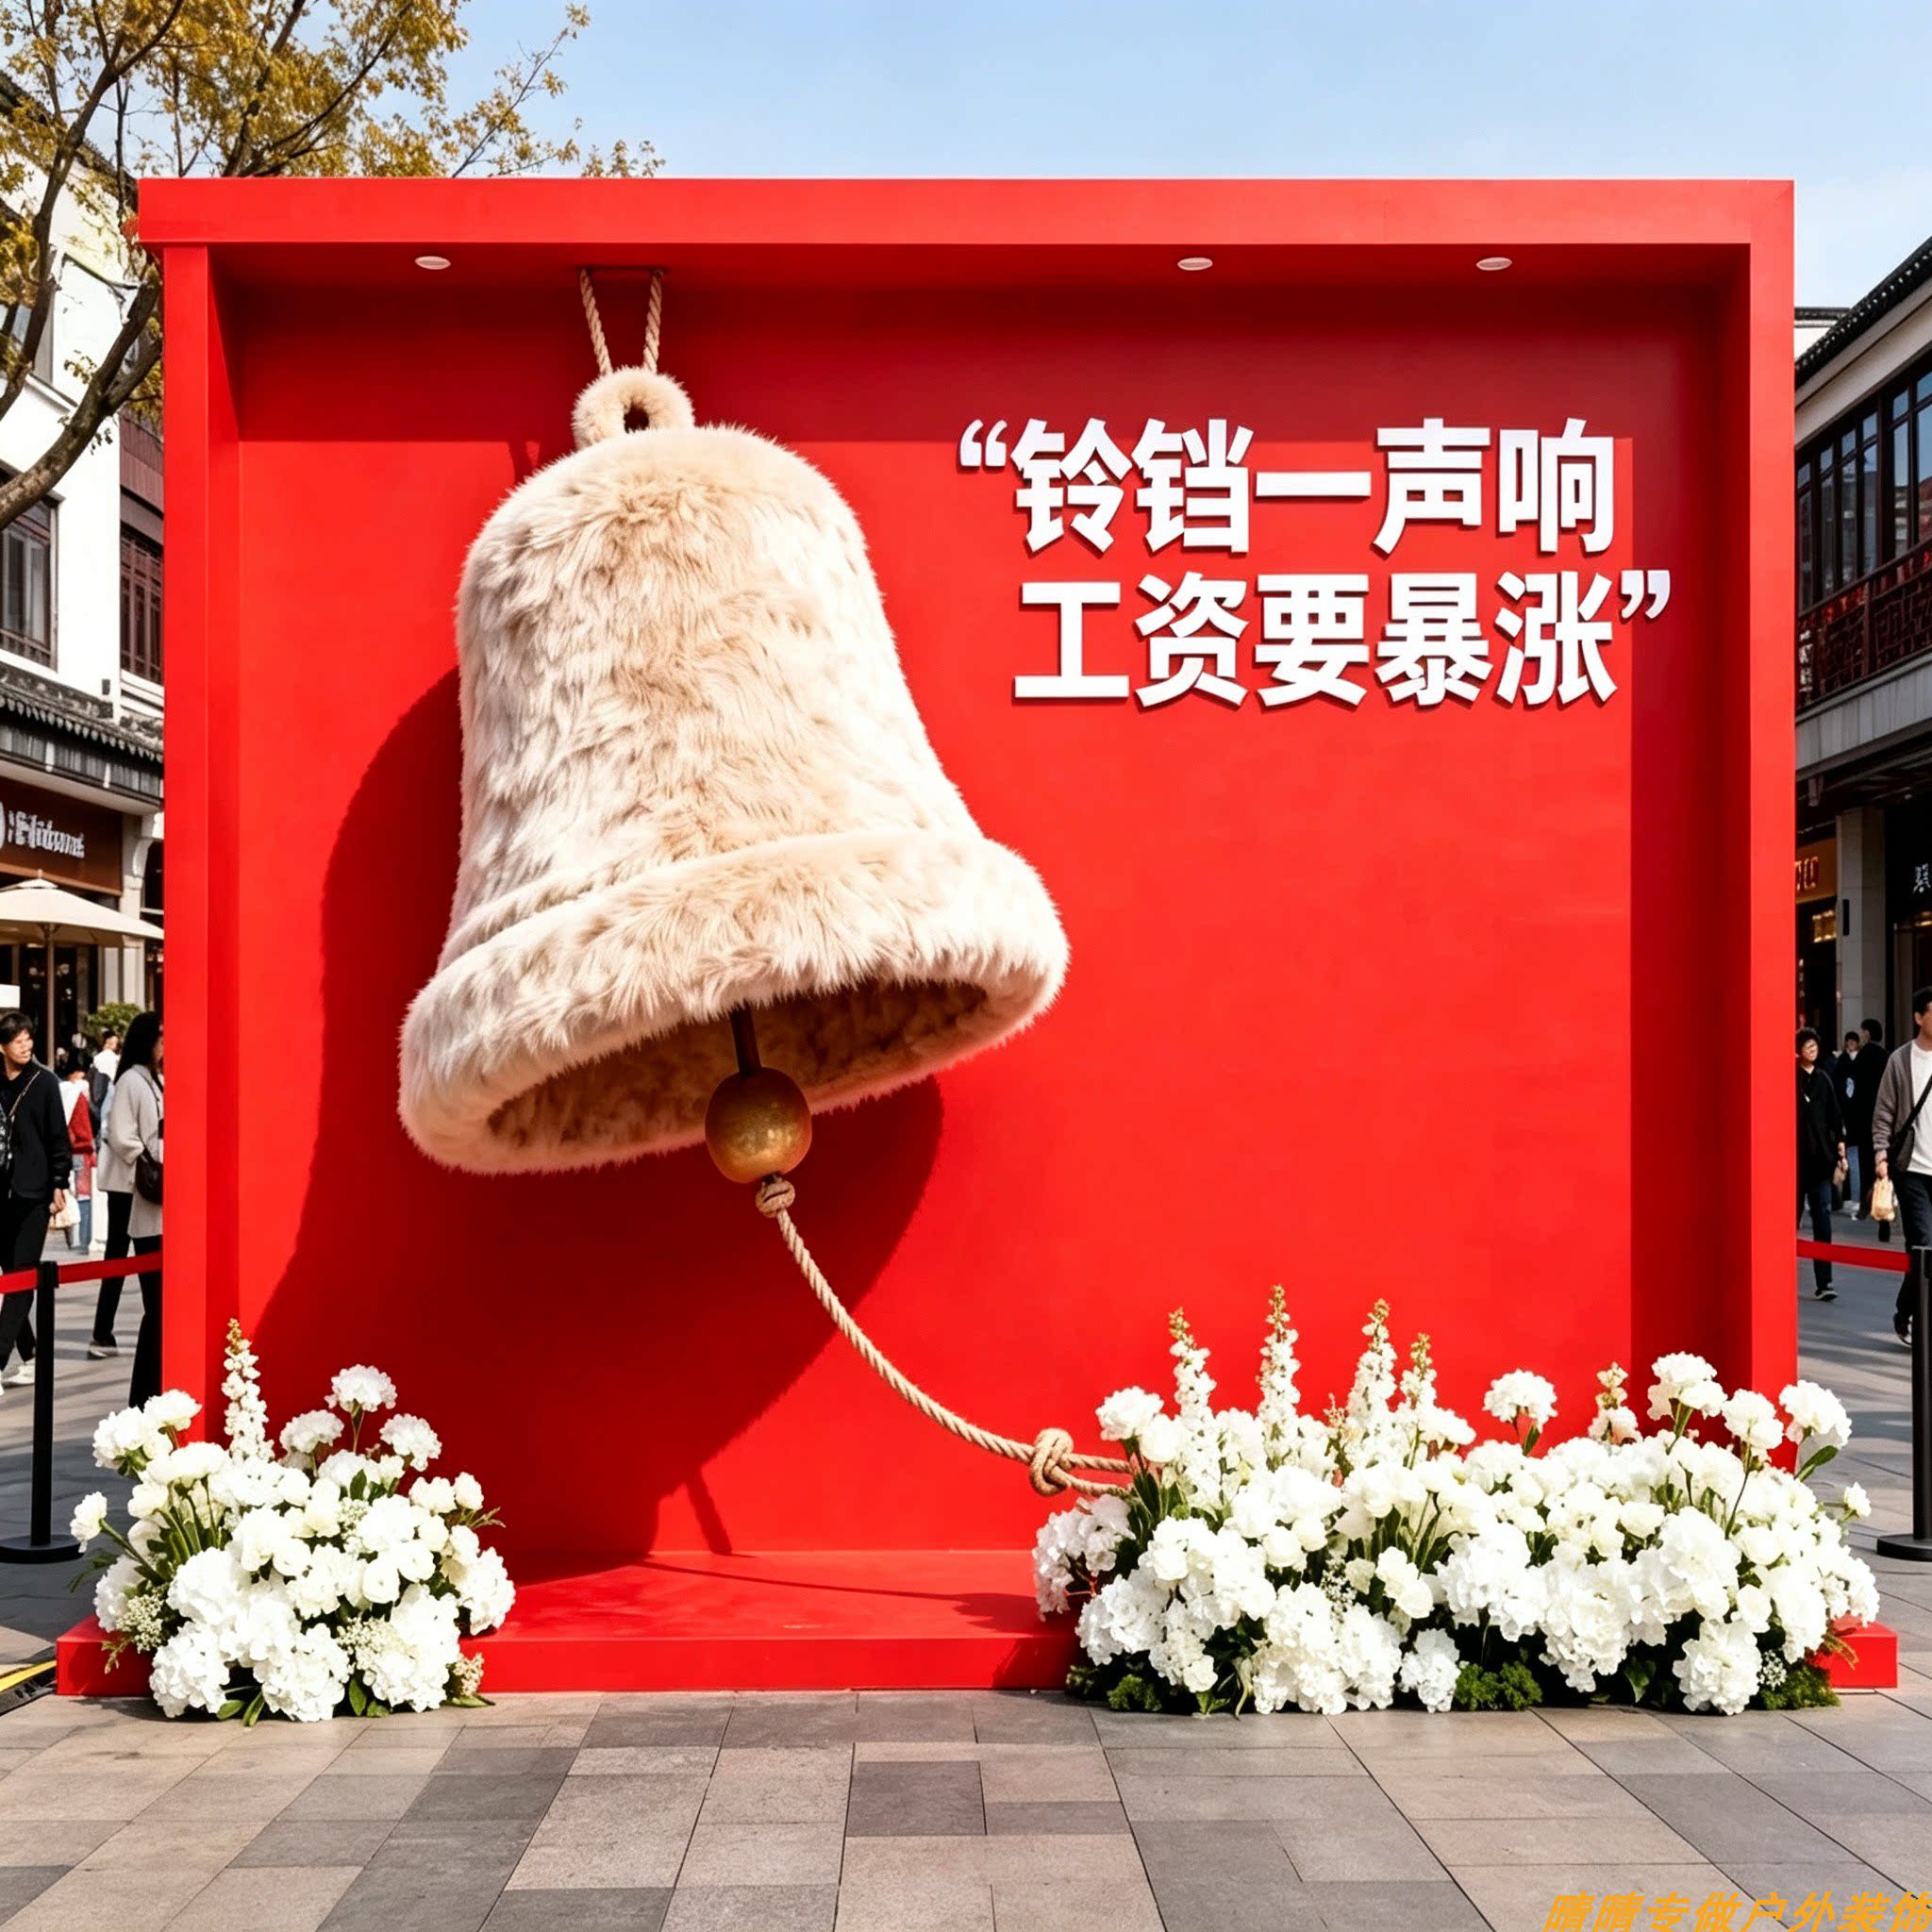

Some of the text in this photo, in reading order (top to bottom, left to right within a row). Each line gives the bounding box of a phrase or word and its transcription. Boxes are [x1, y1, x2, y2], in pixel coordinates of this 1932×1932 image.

[959, 417, 1615, 555] “铃铛一声响
[1014, 570, 1671, 708] 工资要暴涨”
